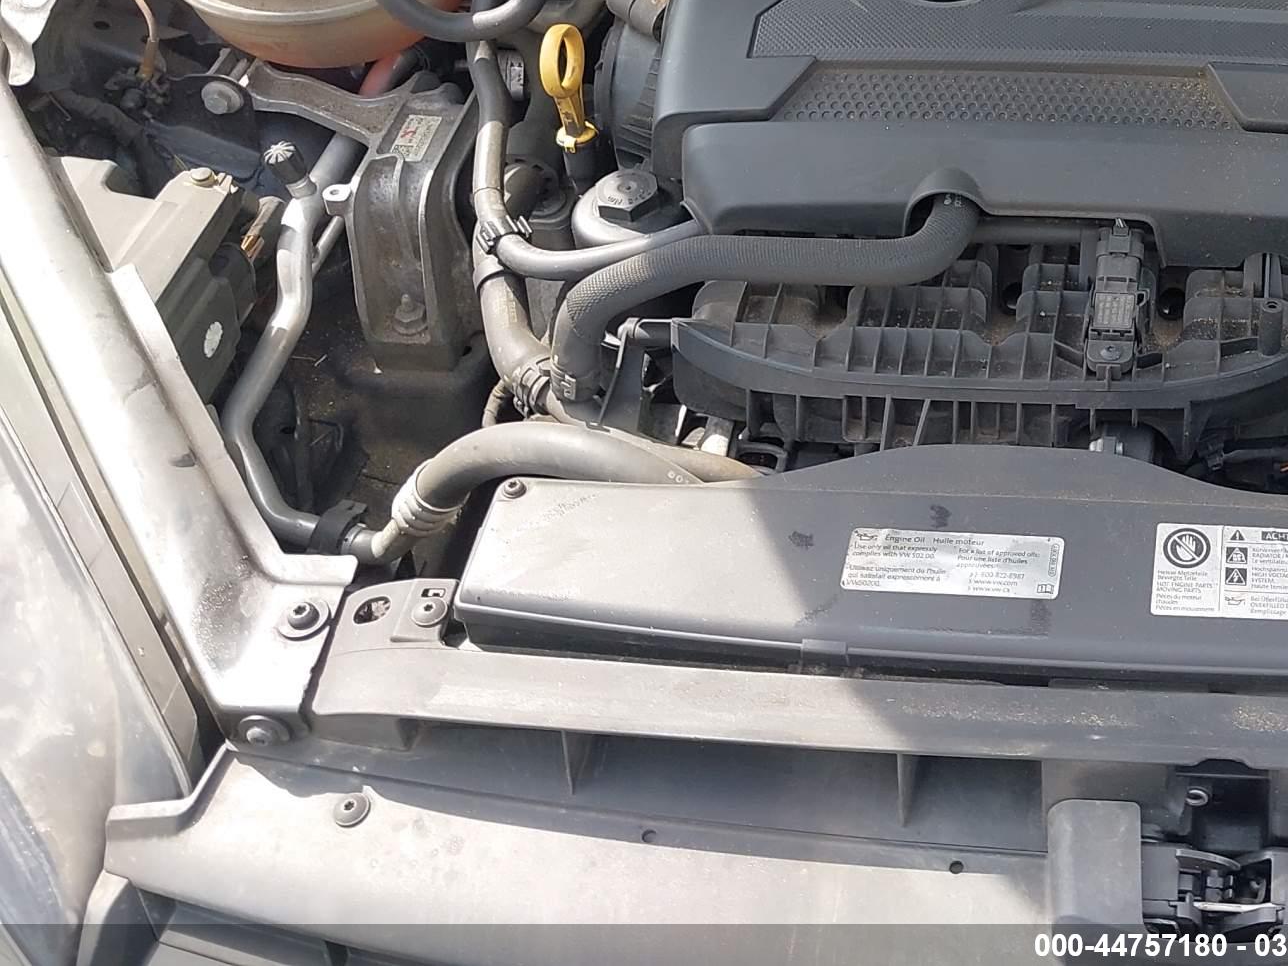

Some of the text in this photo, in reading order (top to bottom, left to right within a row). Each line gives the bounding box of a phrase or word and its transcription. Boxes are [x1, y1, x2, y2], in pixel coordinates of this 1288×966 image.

[885, 533, 912, 543] Engine
[932, 537, 954, 545] Huile
[955, 538, 985, 546] moteur
